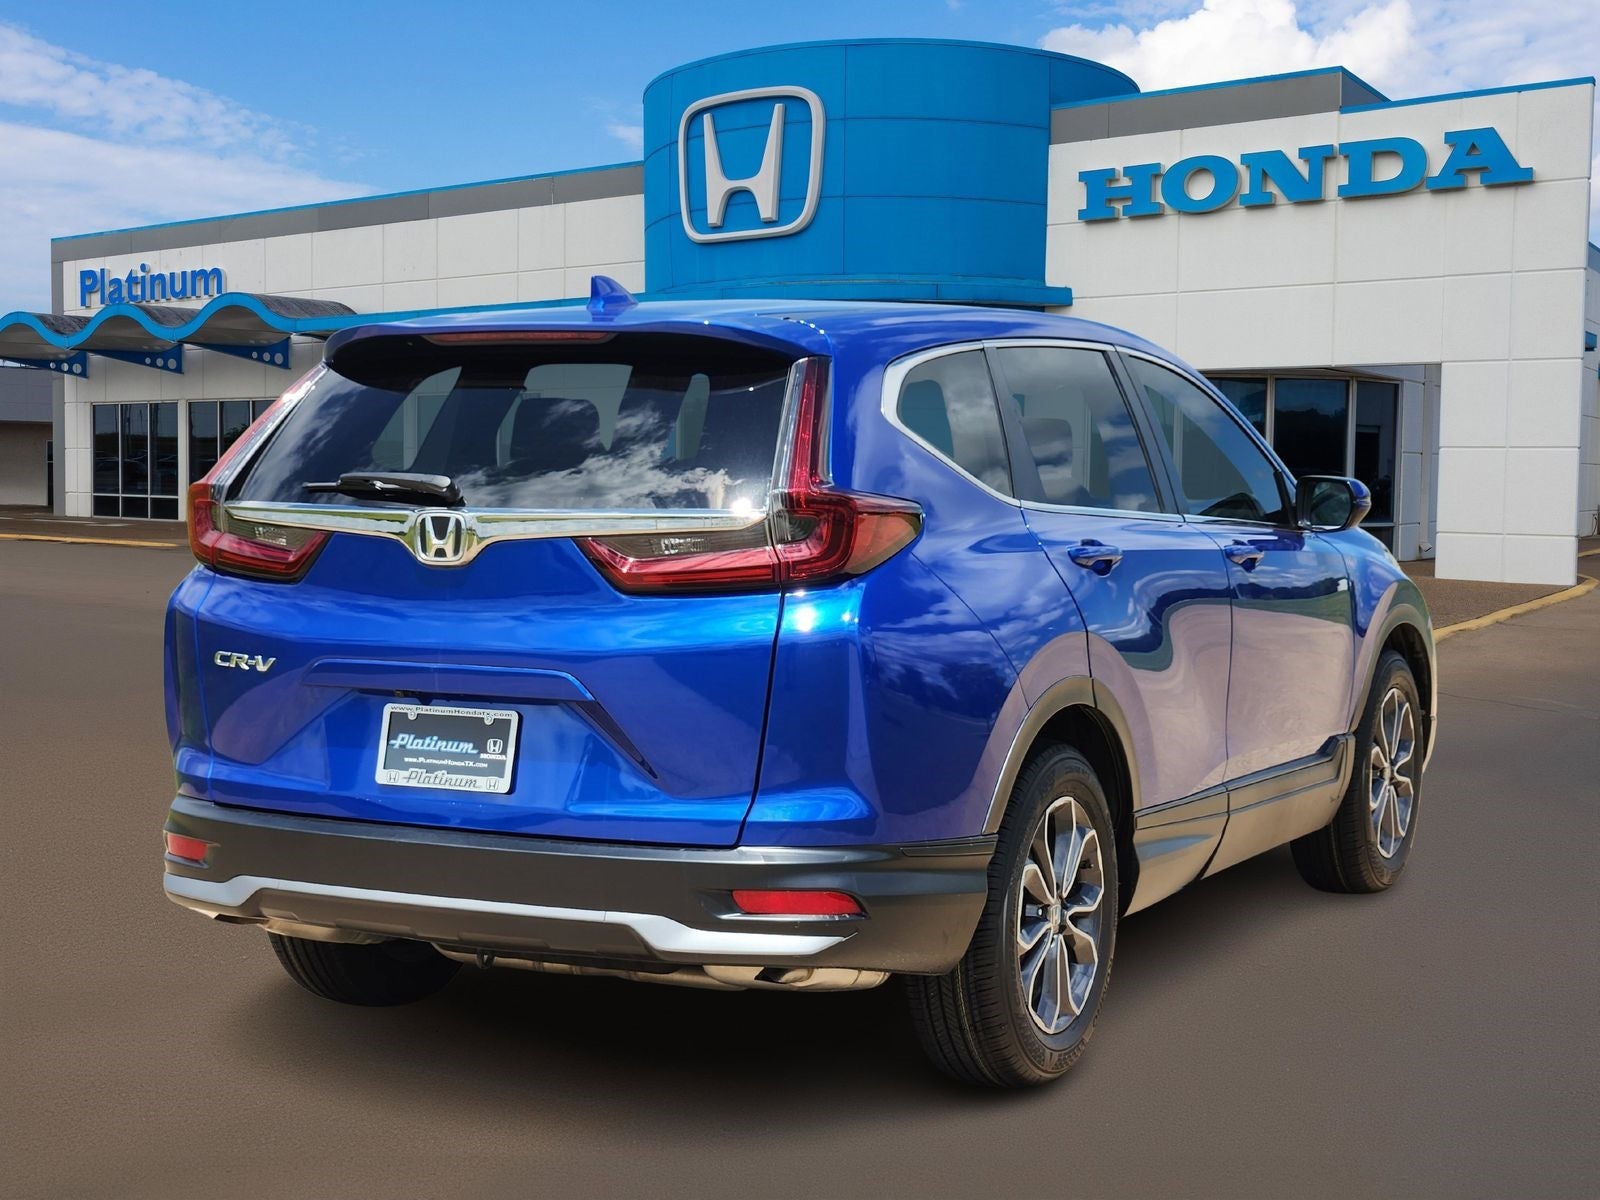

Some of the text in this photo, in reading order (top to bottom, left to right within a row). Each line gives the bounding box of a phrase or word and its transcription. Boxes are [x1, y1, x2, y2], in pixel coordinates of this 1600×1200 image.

[1078, 126, 1534, 221] HONDA
[79, 263, 223, 307] Platinum
[214, 650, 276, 672] CR-V
[389, 733, 480, 754] Platinum
[403, 770, 481, 789] Platinum
